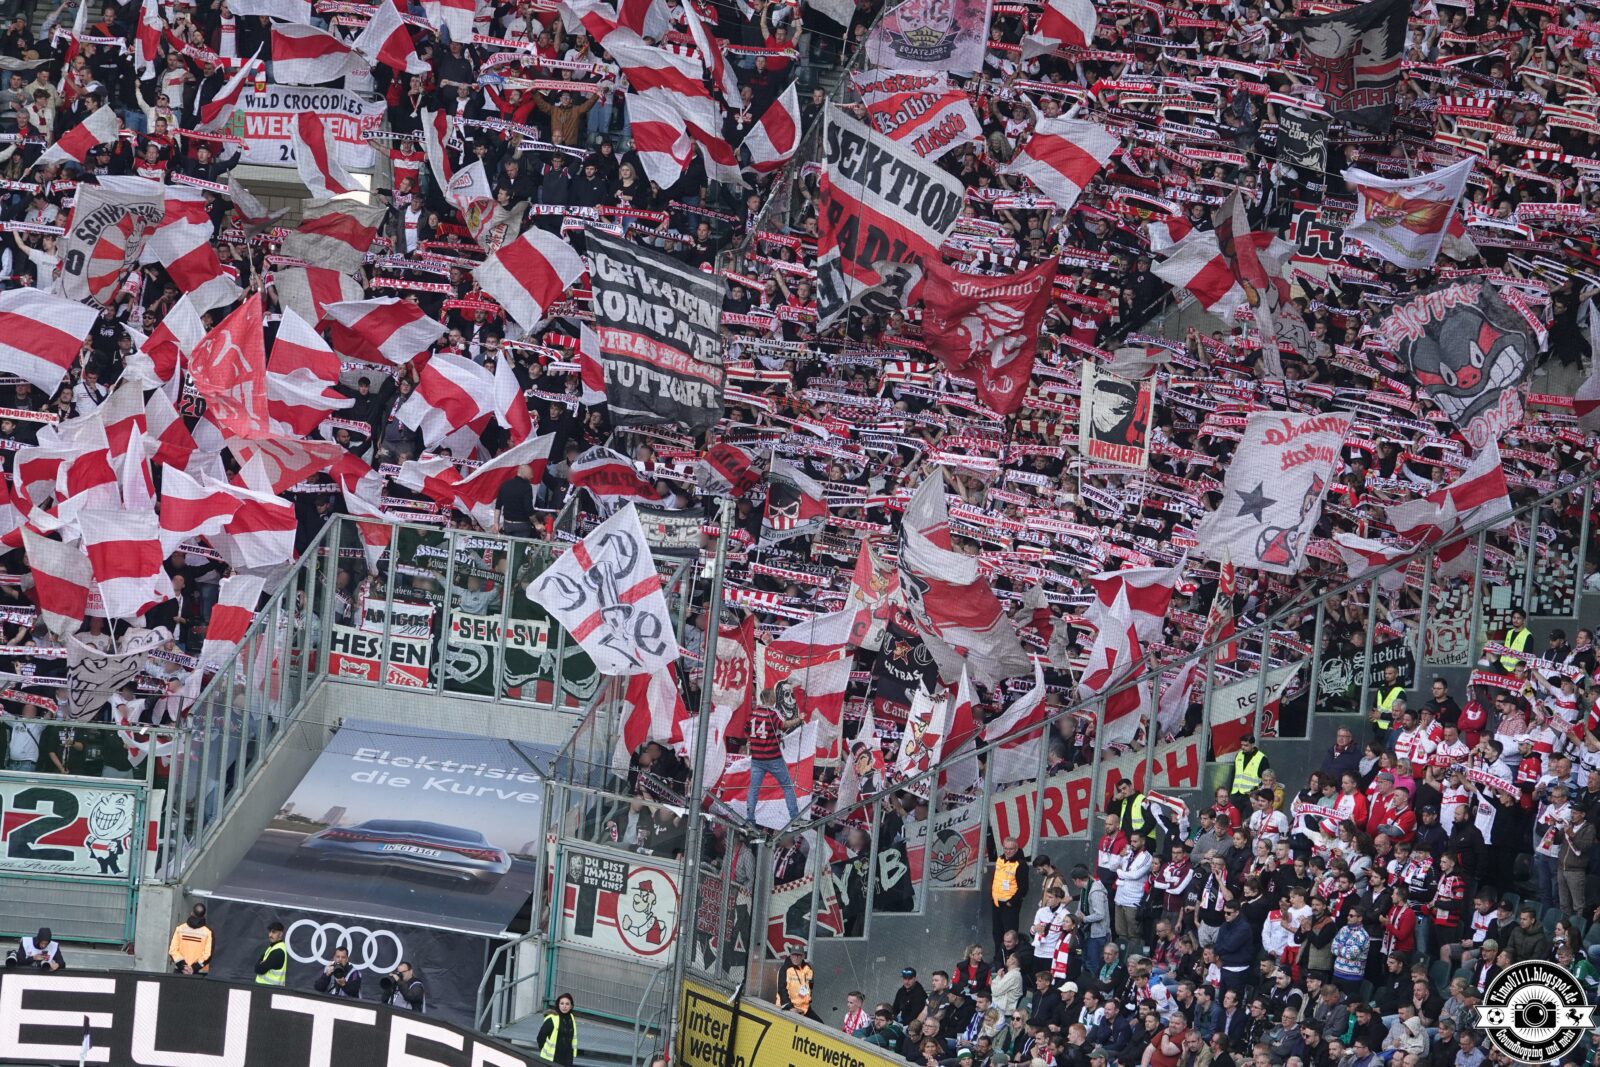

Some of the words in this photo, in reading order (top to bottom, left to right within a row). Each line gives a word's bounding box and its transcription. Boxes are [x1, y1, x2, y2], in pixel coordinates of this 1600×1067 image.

[473, 34, 530, 48] STUTTGART
[558, 61, 592, 70] Stuttgart
[1101, 79, 1117, 88] VfB
[245, 94, 280, 109] WILD
[284, 93, 363, 115] CROCODILES
[874, 92, 943, 135] Kolben
[1289, 129, 1311, 142] COPS
[1496, 133, 1529, 146] NIEMALS
[826, 120, 962, 234] SEKTION
[739, 335, 760, 344] VfB
[181, 396, 206, 417] 20
[1168, 391, 1218, 409] STUTTGART
[1088, 438, 1146, 467] INFIZIERT
[950, 508, 996, 526] CANNSTATTER
[1001, 521, 1024, 532] KURVE
[1026, 517, 1070, 531] CANNSTATTER
[401, 625, 430, 637] 2010
[459, 616, 499, 644] SEK
[513, 624, 540, 649] SV
[331, 631, 427, 668] HESEN
[750, 716, 769, 740] 14
[351, 770, 411, 789] die
[1468, 770, 1521, 797] STUTTGART
[918, 809, 969, 838] Lintal
[18, 858, 91, 873] Stuttgart
[585, 857, 600, 867] DU
[603, 861, 626, 873] BIST
[584, 876, 600, 886] BEI
[601, 880, 624, 892] UNS!
[585, 868, 624, 884] IMMER
[689, 997, 729, 1042] inter
